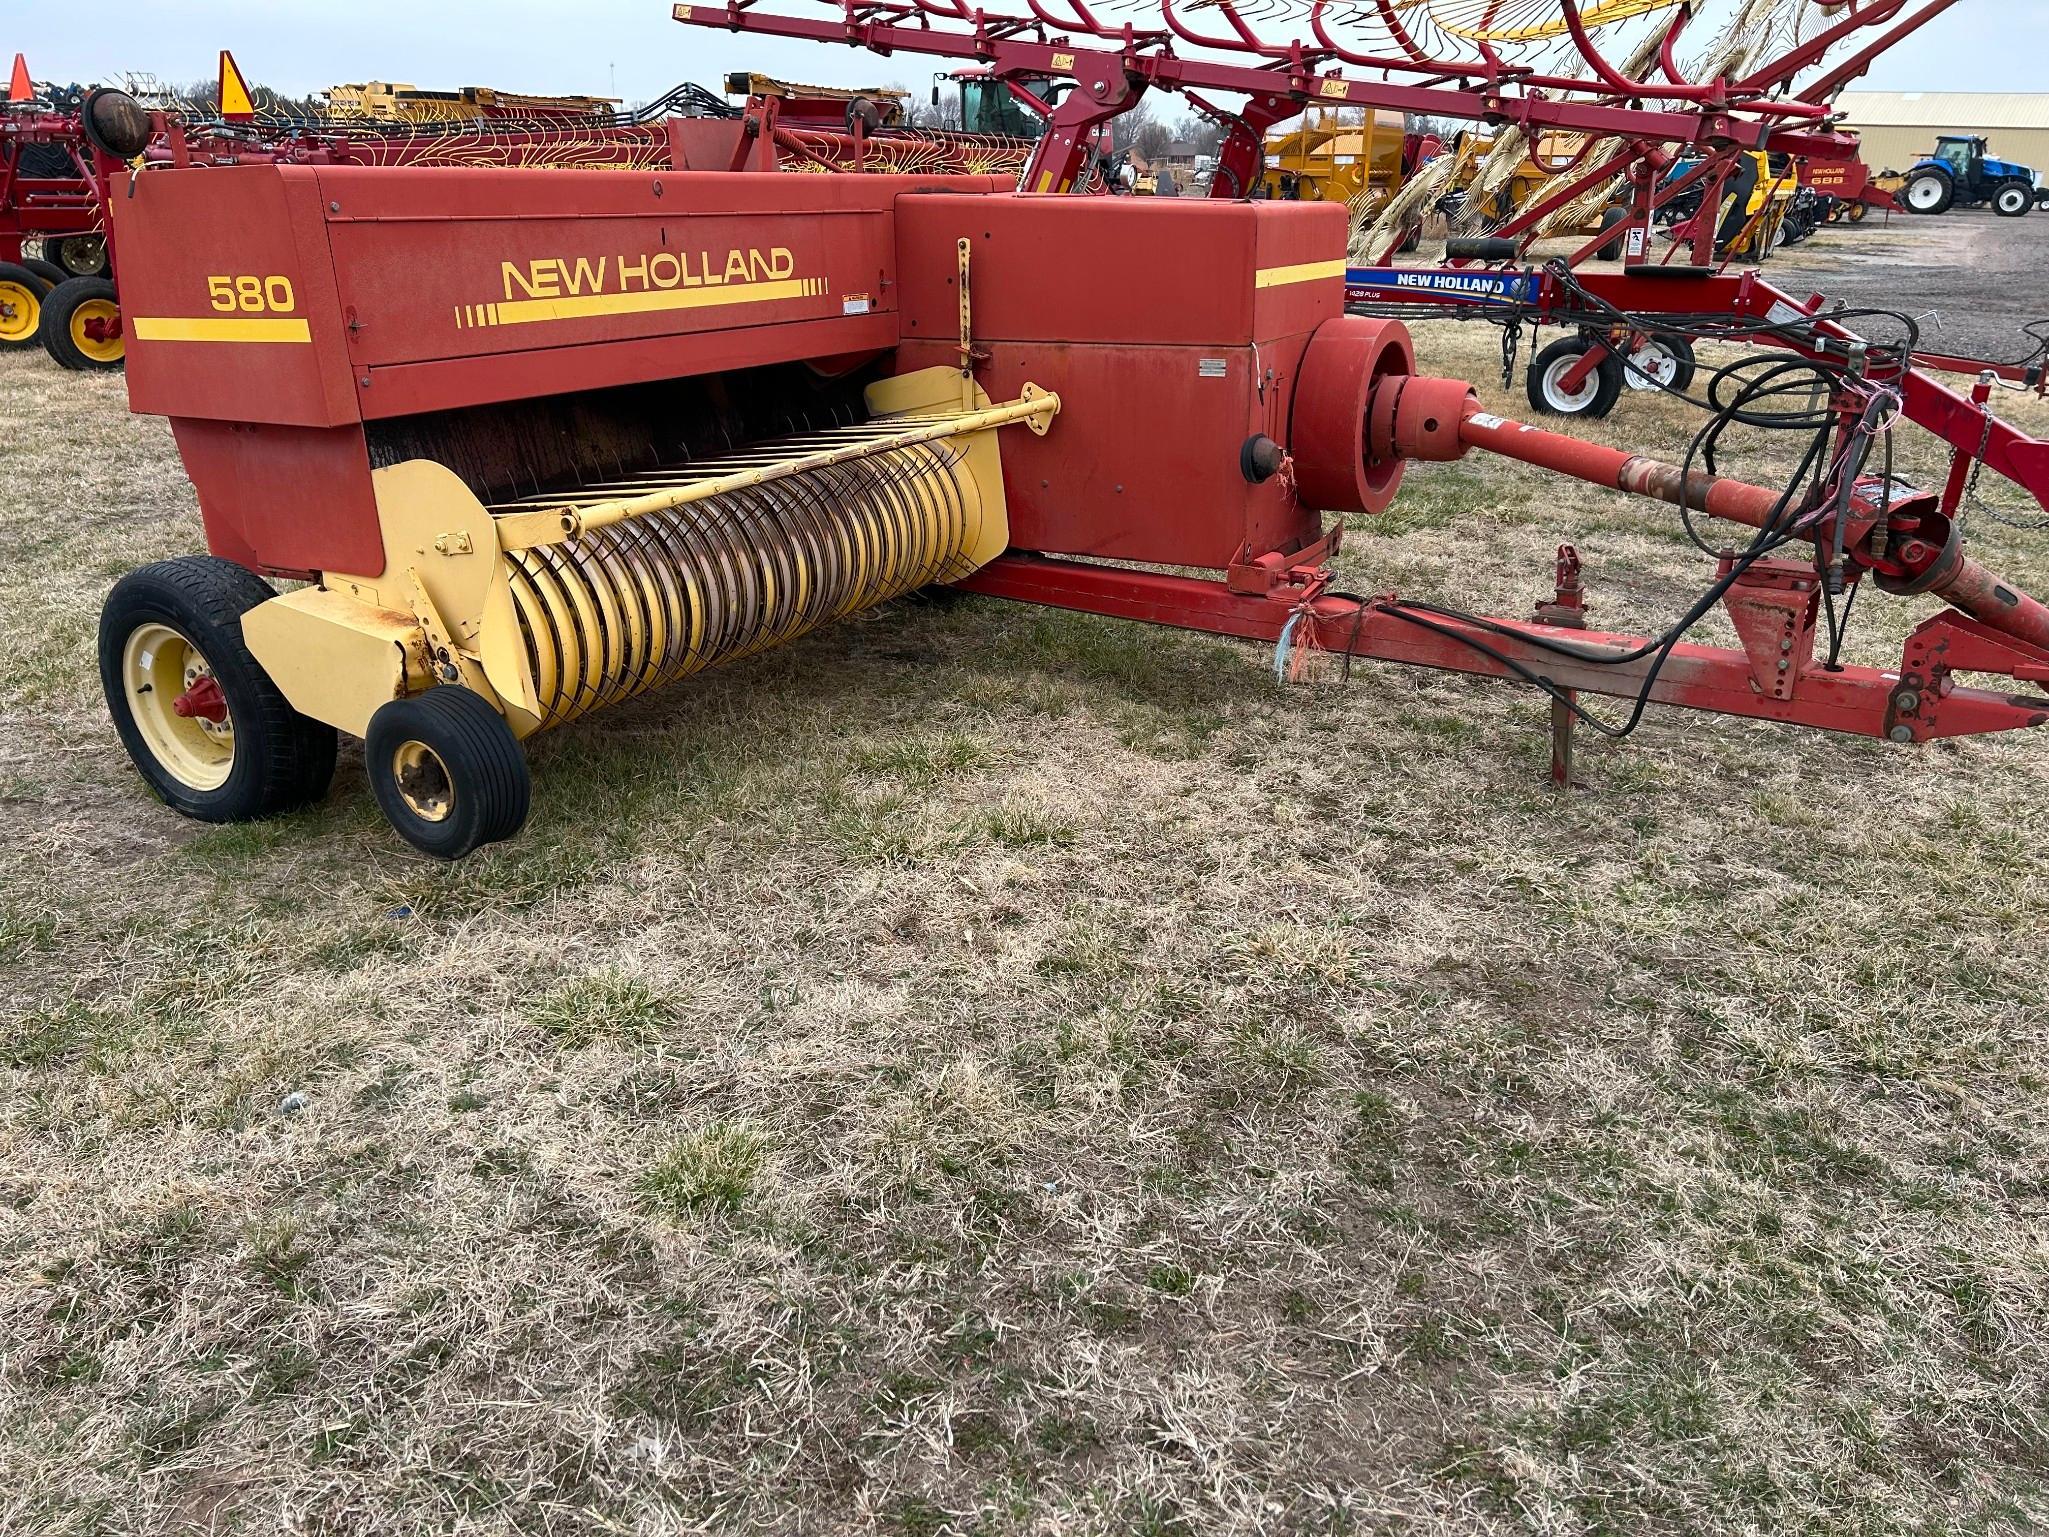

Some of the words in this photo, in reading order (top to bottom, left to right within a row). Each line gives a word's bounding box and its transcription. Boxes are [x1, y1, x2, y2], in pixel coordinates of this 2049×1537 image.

[1811, 176, 1844, 184] 688
[502, 256, 606, 299] NEW
[618, 247, 794, 291] HOLLAND
[1397, 273, 1432, 287] NEW
[1434, 275, 1504, 294] HOLLAND
[207, 275, 295, 312] 580
